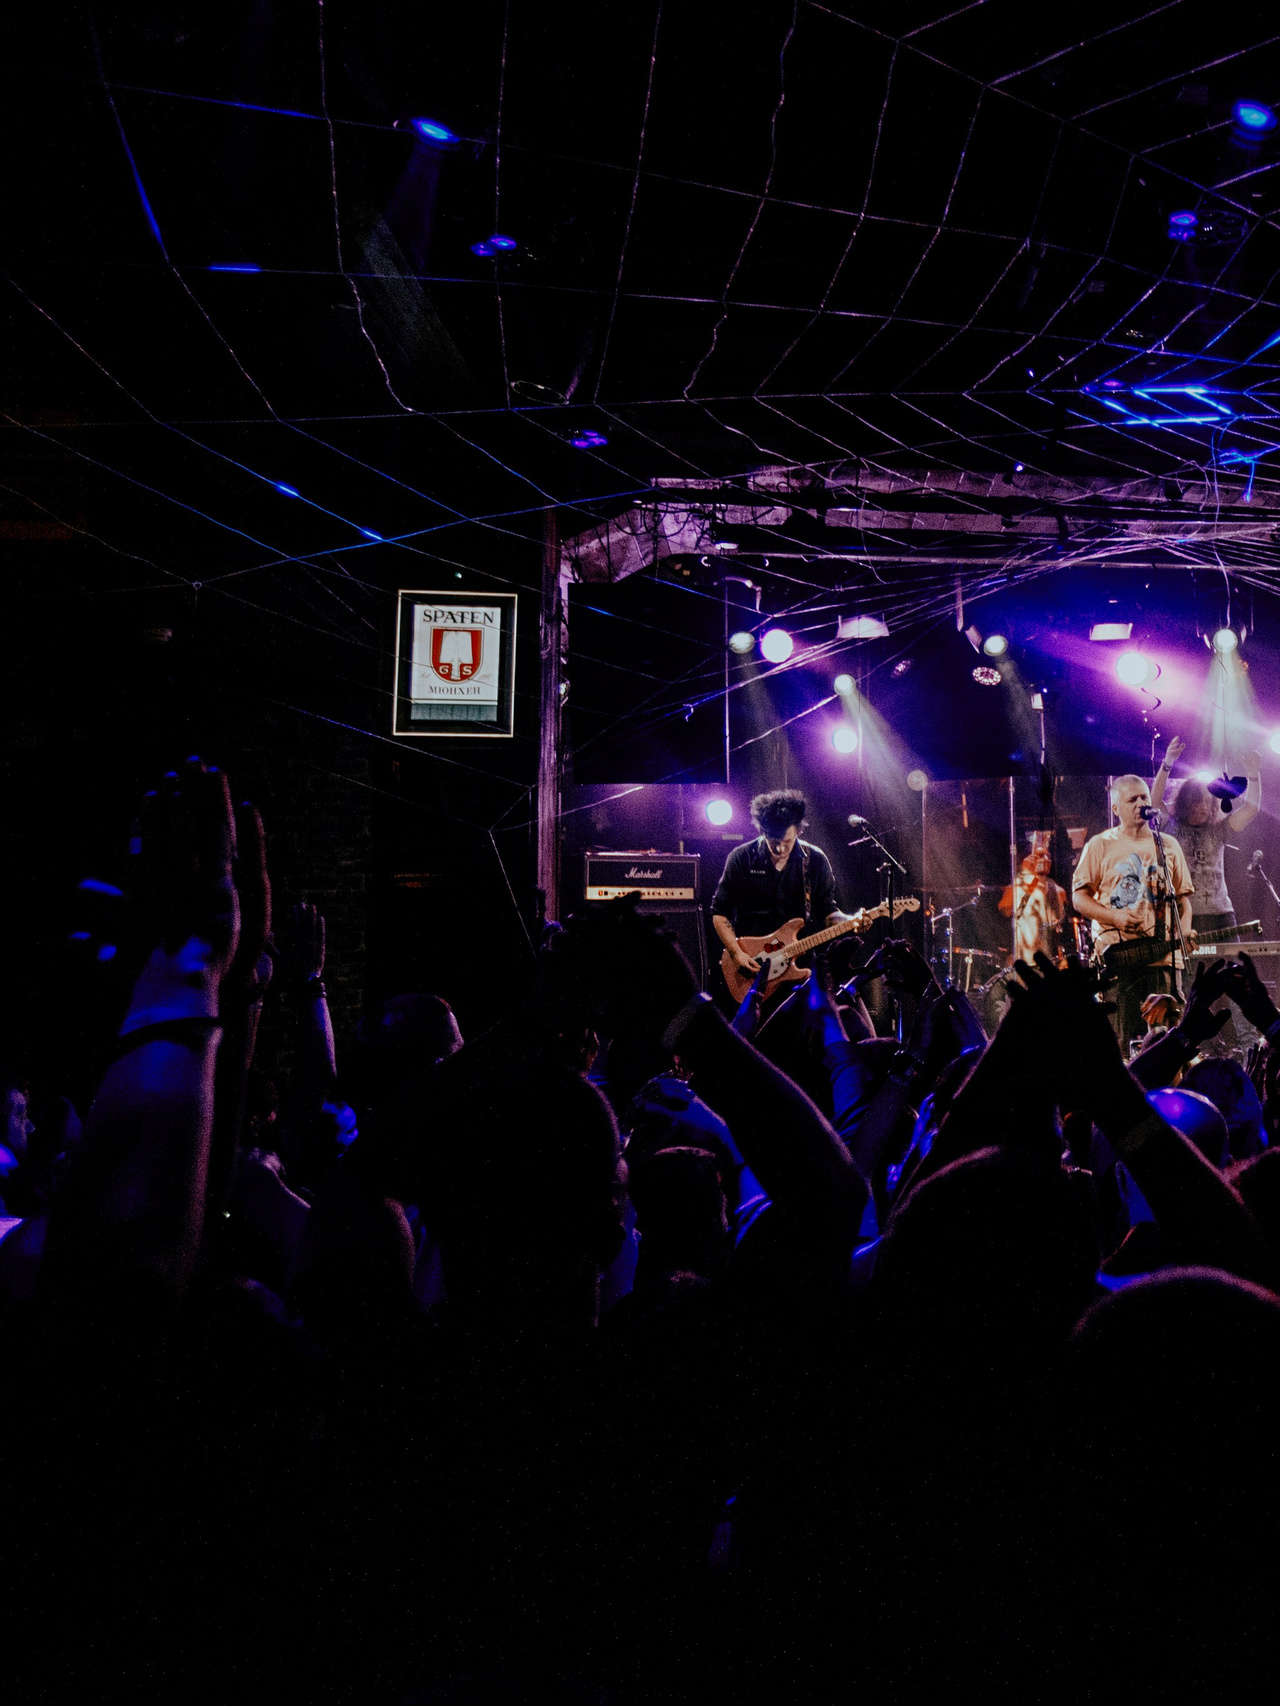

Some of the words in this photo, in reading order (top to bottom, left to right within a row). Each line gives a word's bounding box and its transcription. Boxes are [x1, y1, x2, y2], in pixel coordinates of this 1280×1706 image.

[422, 609, 495, 624] SPATEN
[439, 665, 450, 675] G
[462, 665, 473, 675] S
[625, 867, 663, 879] Marshall
